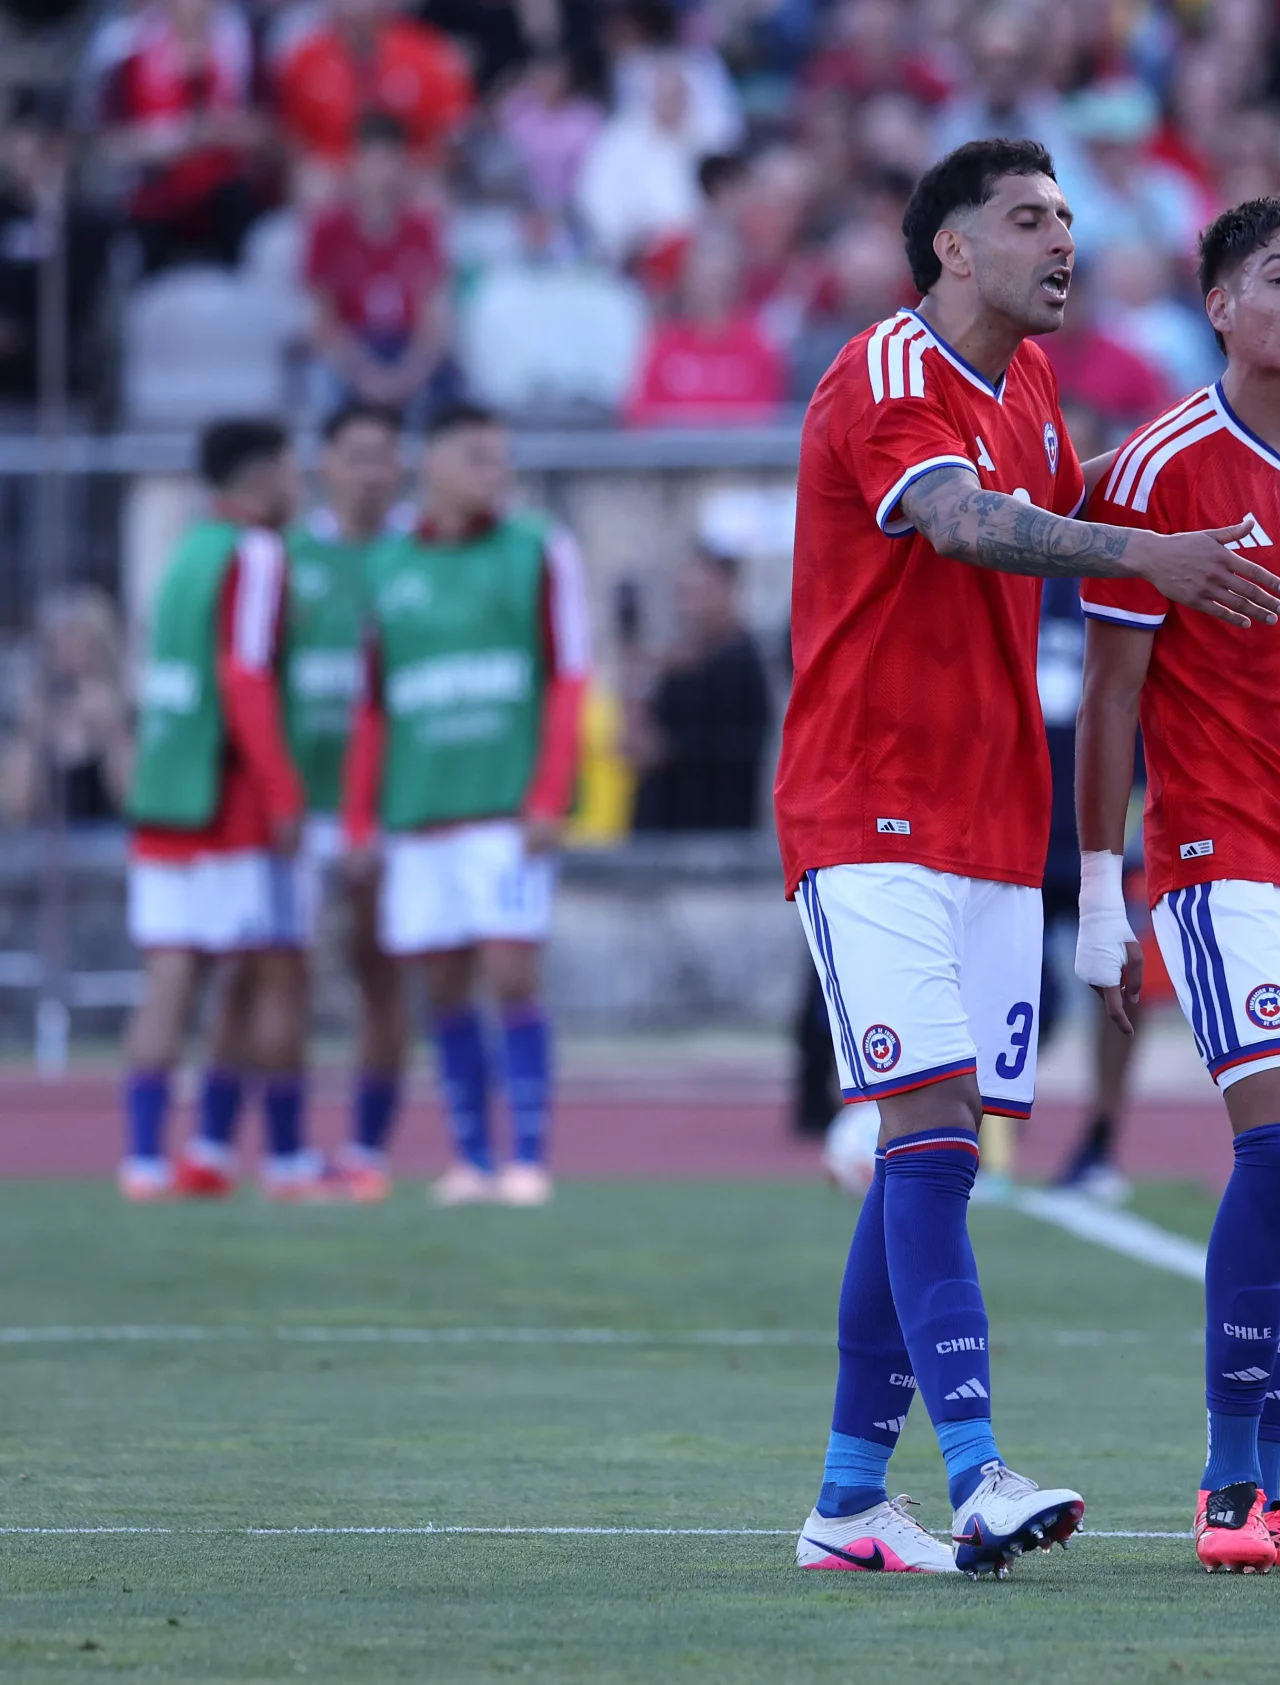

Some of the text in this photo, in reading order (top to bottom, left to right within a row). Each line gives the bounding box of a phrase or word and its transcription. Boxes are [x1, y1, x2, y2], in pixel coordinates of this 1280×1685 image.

[995, 1001, 1034, 1080] 3
[1223, 1322, 1272, 1340] CHILE
[935, 1337, 986, 1354] CHILE
